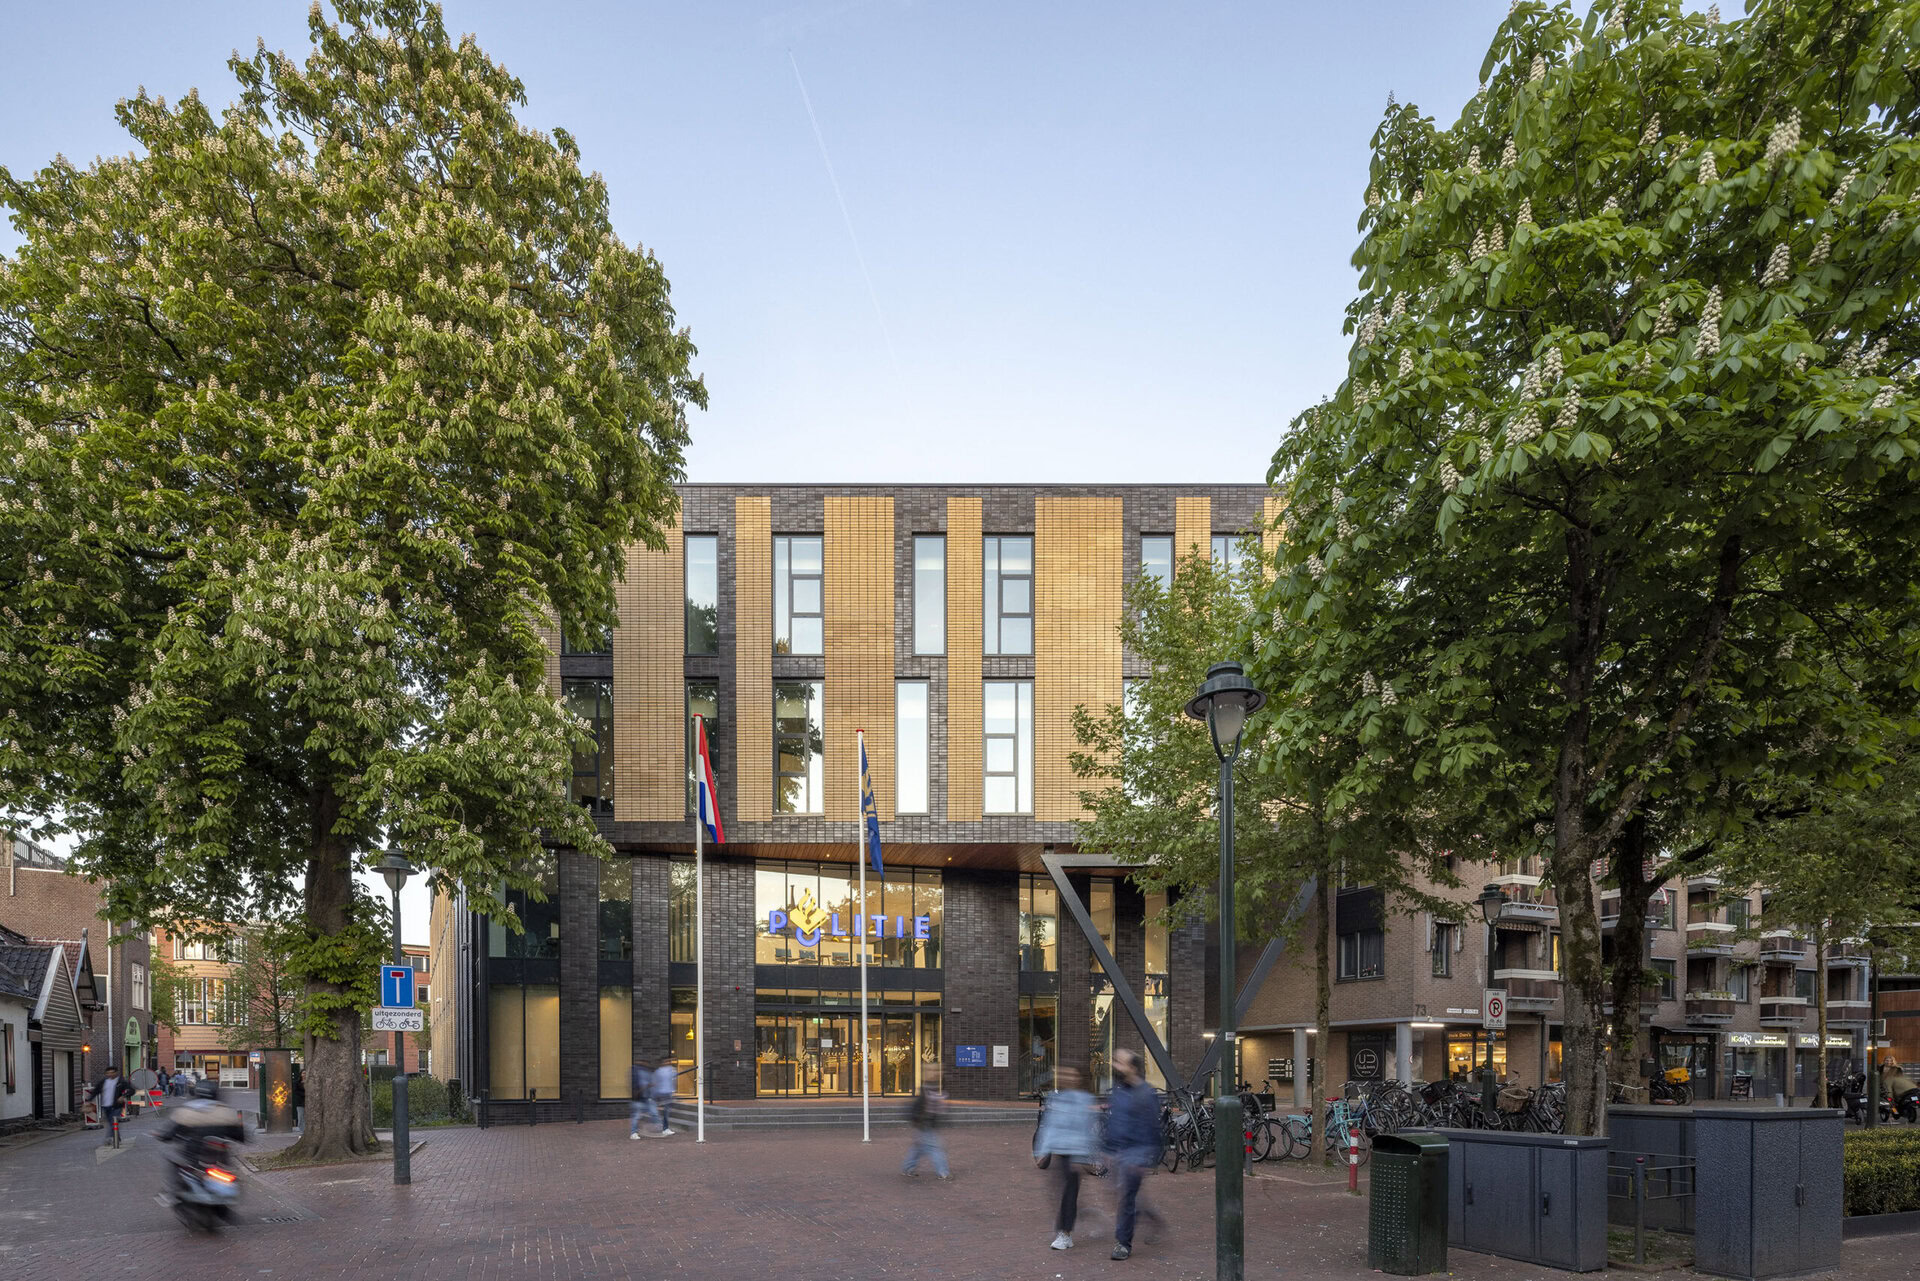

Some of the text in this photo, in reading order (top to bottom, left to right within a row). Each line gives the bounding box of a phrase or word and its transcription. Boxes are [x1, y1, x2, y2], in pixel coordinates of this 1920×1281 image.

[769, 910, 931, 947] POLITIE
[374, 1010, 422, 1018] uitgezonderd
[1415, 1004, 1427, 1016] 73
